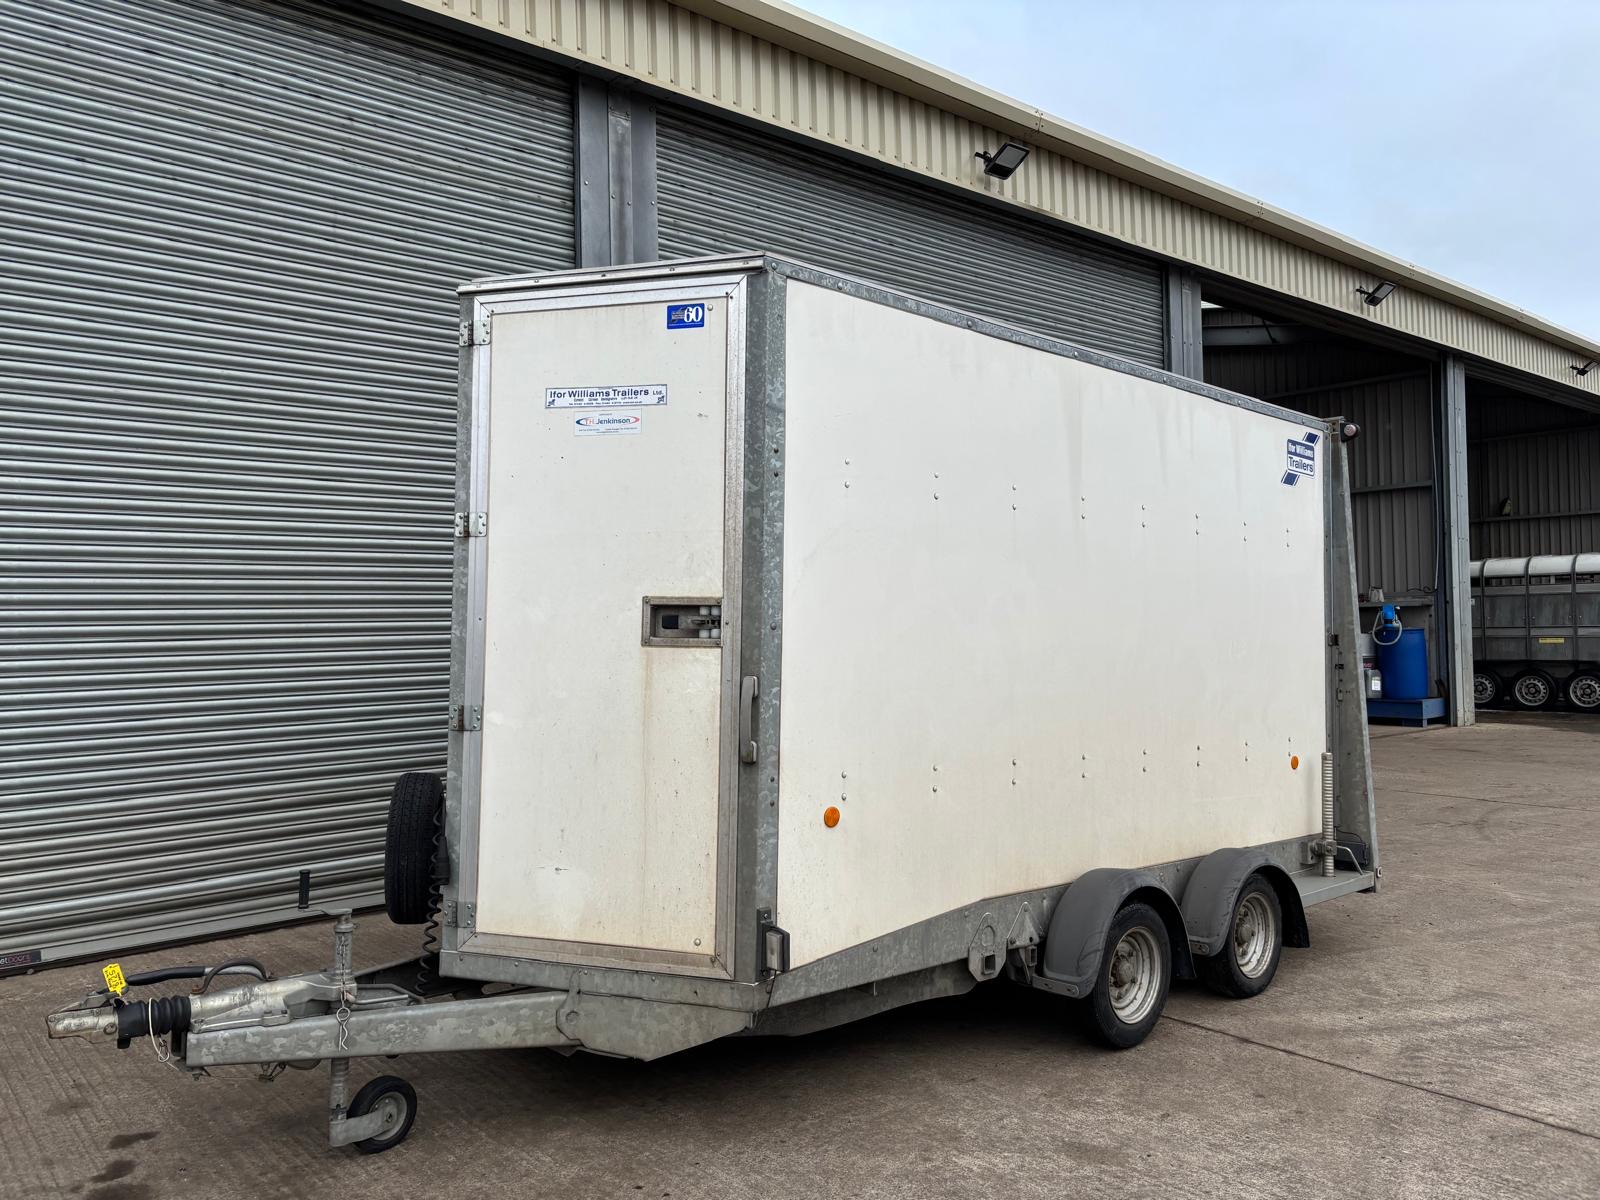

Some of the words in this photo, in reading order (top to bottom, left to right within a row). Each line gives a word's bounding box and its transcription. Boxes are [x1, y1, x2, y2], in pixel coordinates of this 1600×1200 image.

[684, 306, 703, 322] 60
[550, 391, 566, 399] Ifor
[568, 389, 610, 398] Williams
[612, 388, 649, 396] Trailers
[596, 417, 631, 425] Jenkinson
[1288, 456, 1314, 473] Trailers
